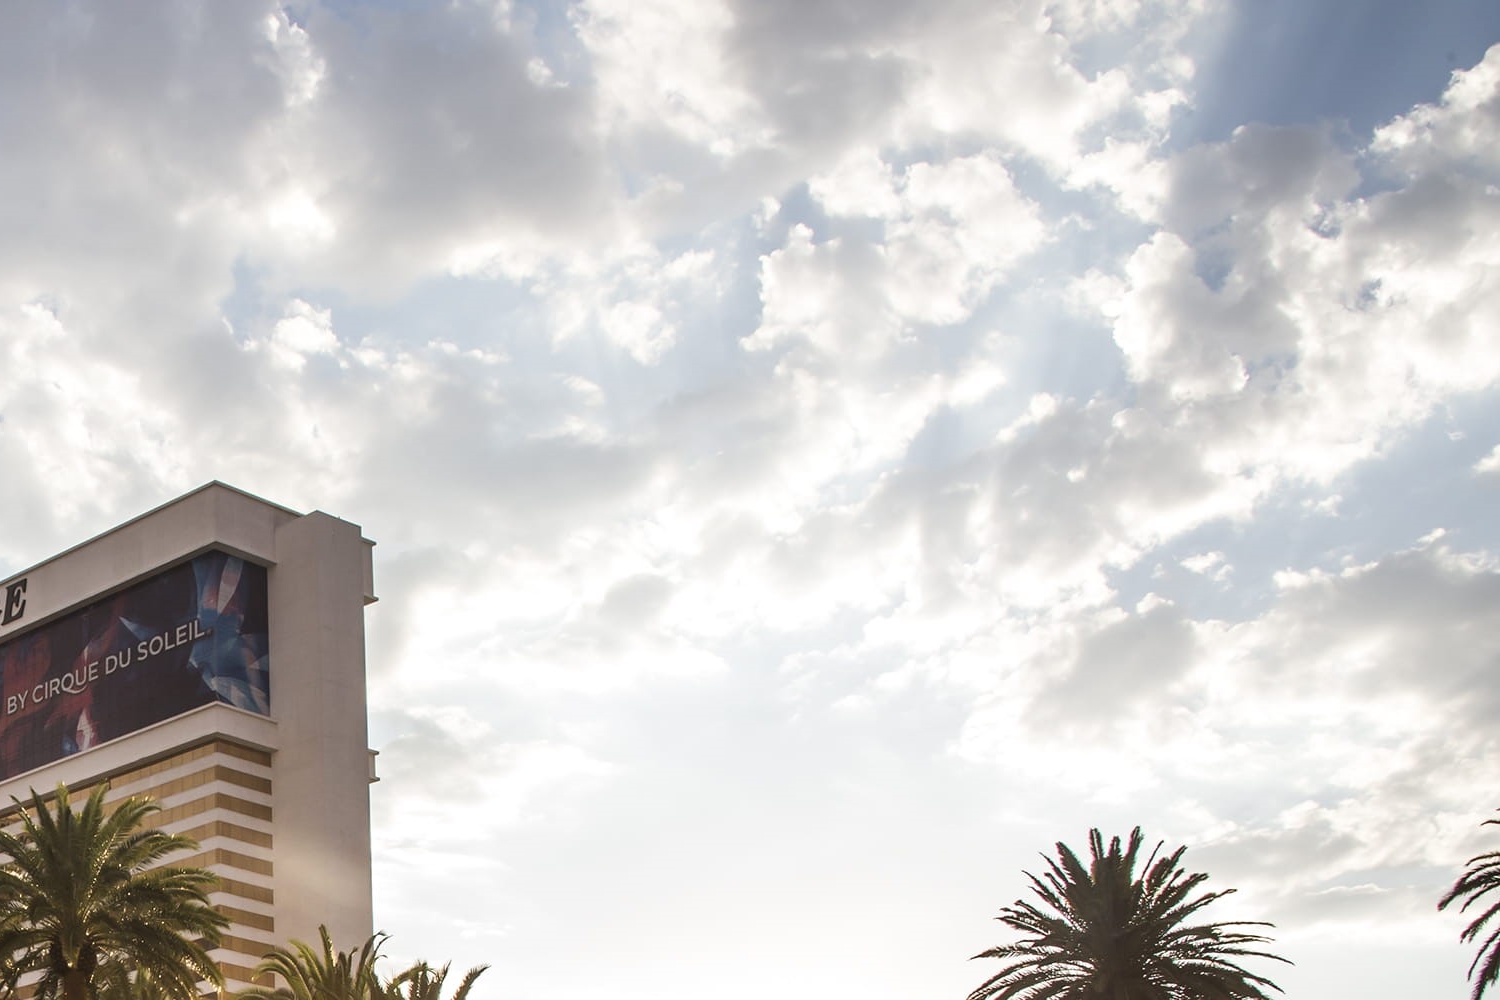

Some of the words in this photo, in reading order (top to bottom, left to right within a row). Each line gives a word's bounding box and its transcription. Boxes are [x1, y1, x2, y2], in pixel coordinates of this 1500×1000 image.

[7, 690, 29, 715] BY
[32, 662, 100, 703] CIRQUE
[105, 648, 131, 675] DU
[137, 619, 205, 661] SOLEIL
